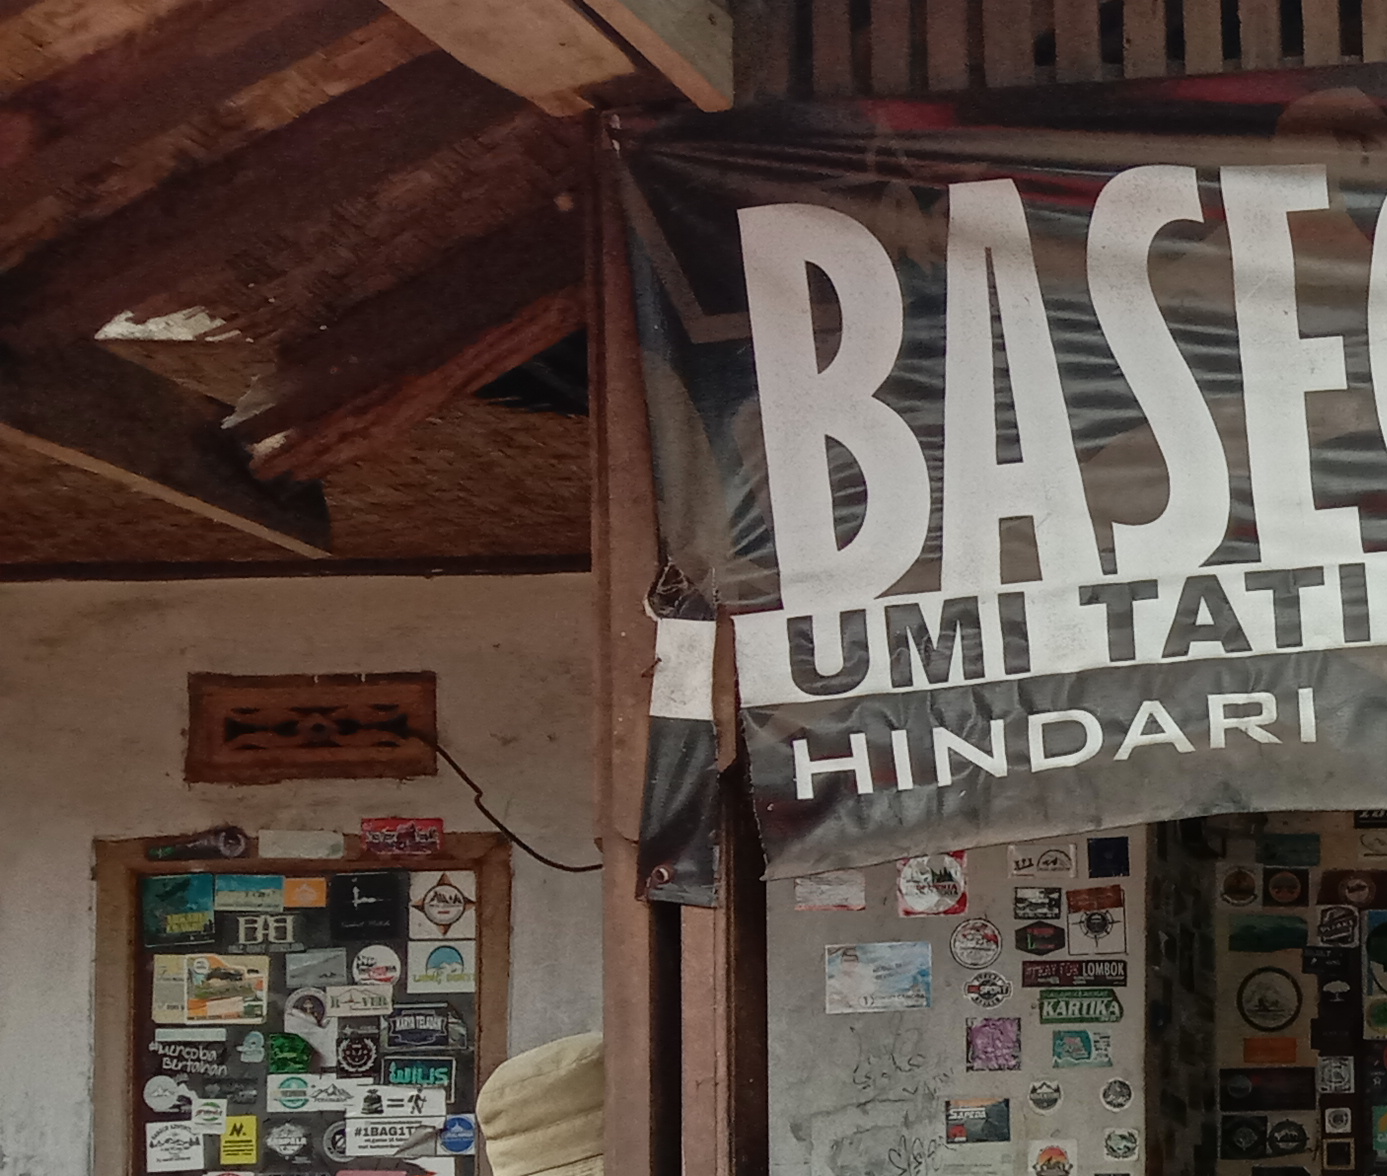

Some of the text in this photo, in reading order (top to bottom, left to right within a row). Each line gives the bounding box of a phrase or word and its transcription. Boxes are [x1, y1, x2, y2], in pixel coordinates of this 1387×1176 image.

[785, 563, 1373, 698] UMI TATI
[793, 685, 1320, 800] HINDARI
[1083, 961, 1126, 977] LOMBOK
[1042, 1000, 1121, 1019] KARTIKA
